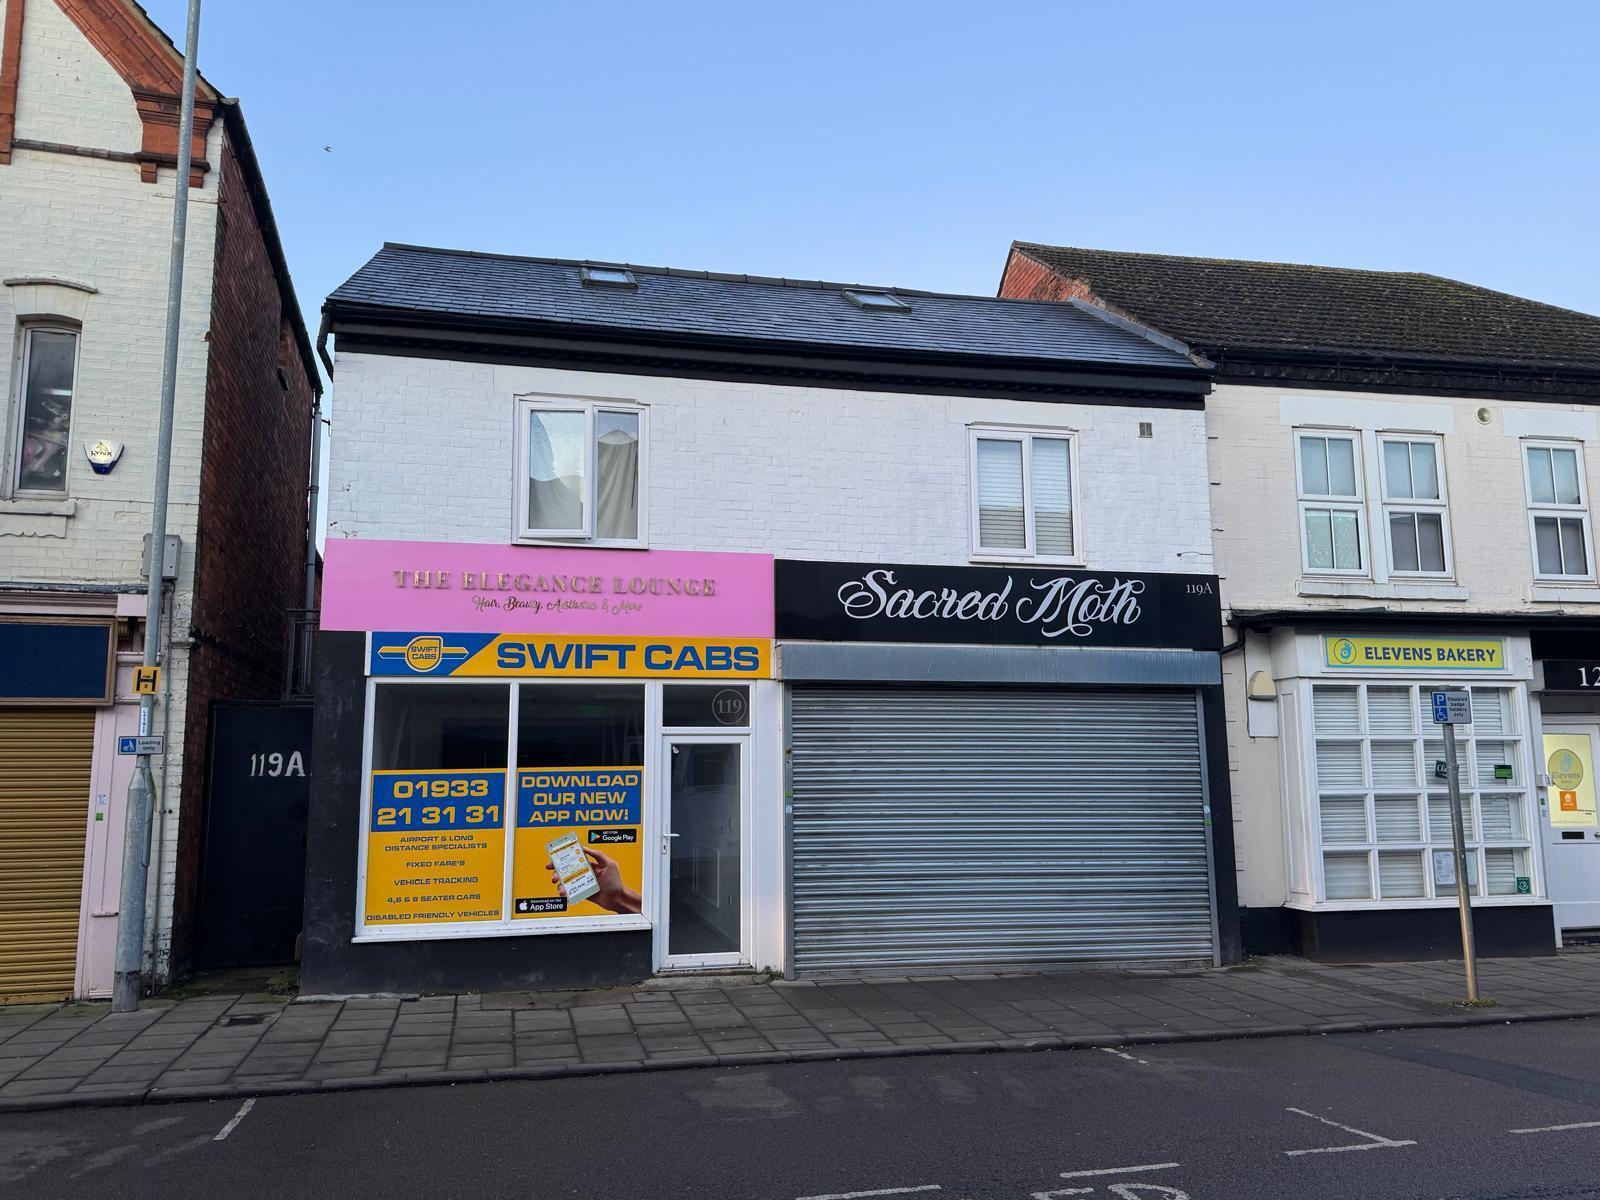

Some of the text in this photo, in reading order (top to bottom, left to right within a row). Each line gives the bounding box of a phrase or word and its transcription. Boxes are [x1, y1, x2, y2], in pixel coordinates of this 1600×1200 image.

[393, 569, 717, 597] THE ELEGANCE LOUNGE
[1185, 582, 1213, 595] 119A
[472, 595, 501, 612] Hair,
[611, 600, 643, 615] More
[837, 569, 1145, 637] Sacred Moth
[410, 645, 439, 653] SWIFT
[1364, 646, 1496, 662] ELEVENS BAKERY
[497, 642, 760, 671] SWIFT CABS
[136, 669, 157, 692] H
[1436, 694, 1444, 705] P
[716, 700, 743, 714] 119
[250, 751, 305, 777] 119A
[521, 774, 639, 788] DOWNLOAD
[393, 779, 489, 798] 01933
[533, 791, 627, 805] OUR NEW
[377, 805, 499, 825] 21 31 31
[529, 808, 629, 823] APP NOW!
[602, 834, 634, 842] Google Play
[394, 876, 478, 886] VEHICLE TRACKING
[456, 893, 481, 901] CARS
[530, 902, 564, 911] App Store
[366, 913, 411, 921] DISABLED
[457, 910, 500, 918] VEHICLES
